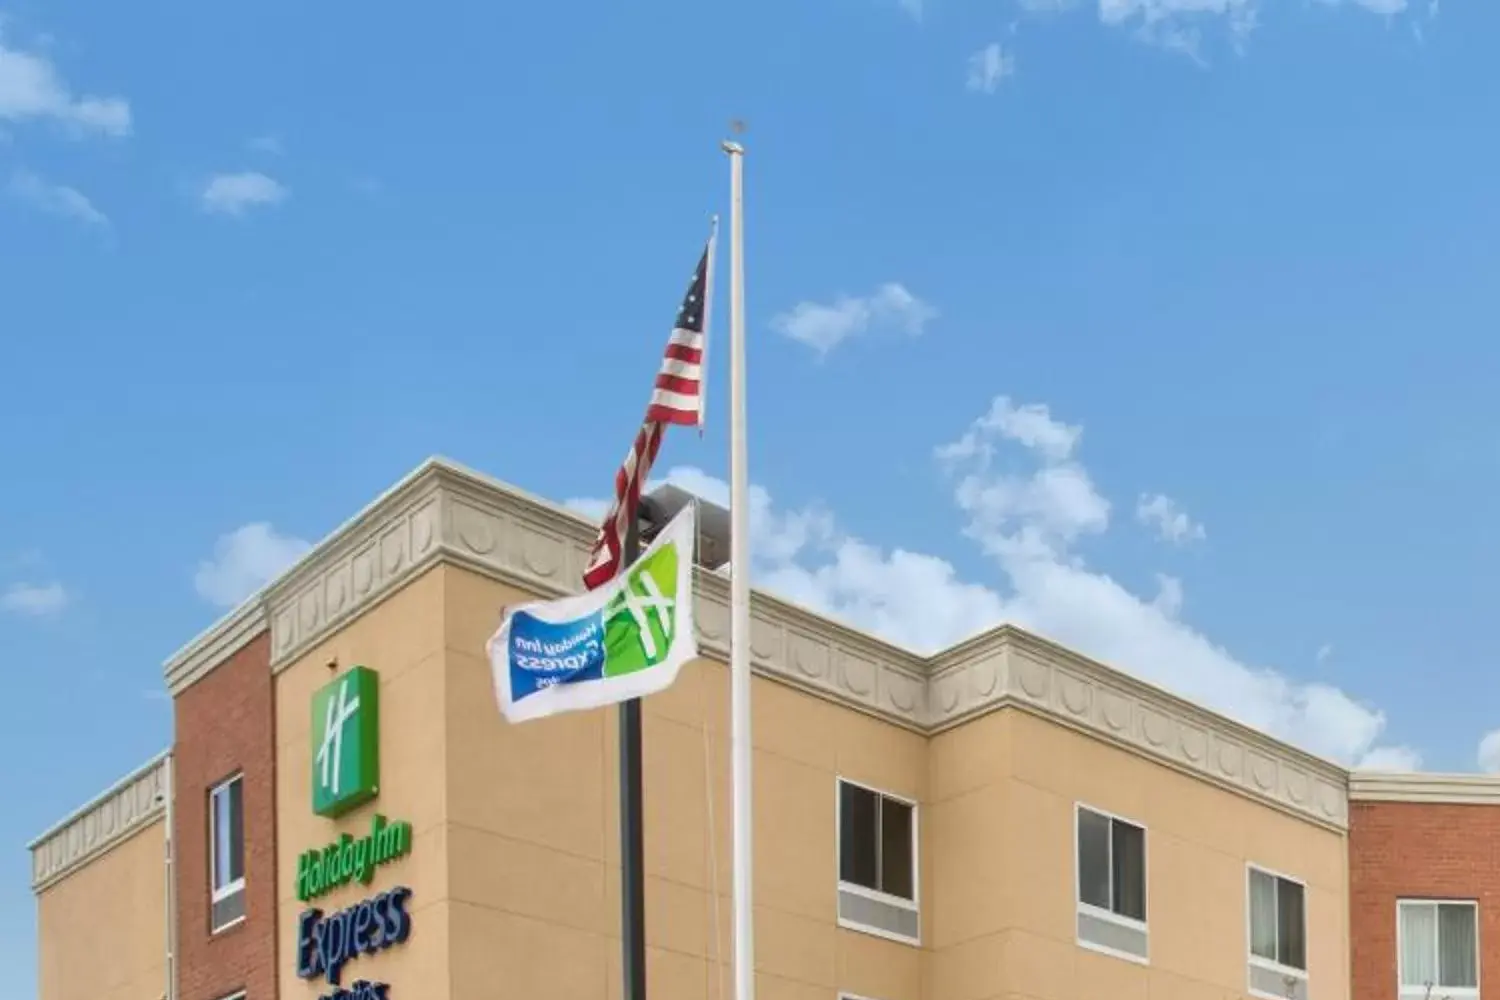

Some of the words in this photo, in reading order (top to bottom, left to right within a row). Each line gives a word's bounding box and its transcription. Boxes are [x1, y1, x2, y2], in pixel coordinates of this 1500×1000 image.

[296, 832, 374, 900] Holiday
[370, 814, 412, 866] Inn
[297, 886, 412, 985] Express
